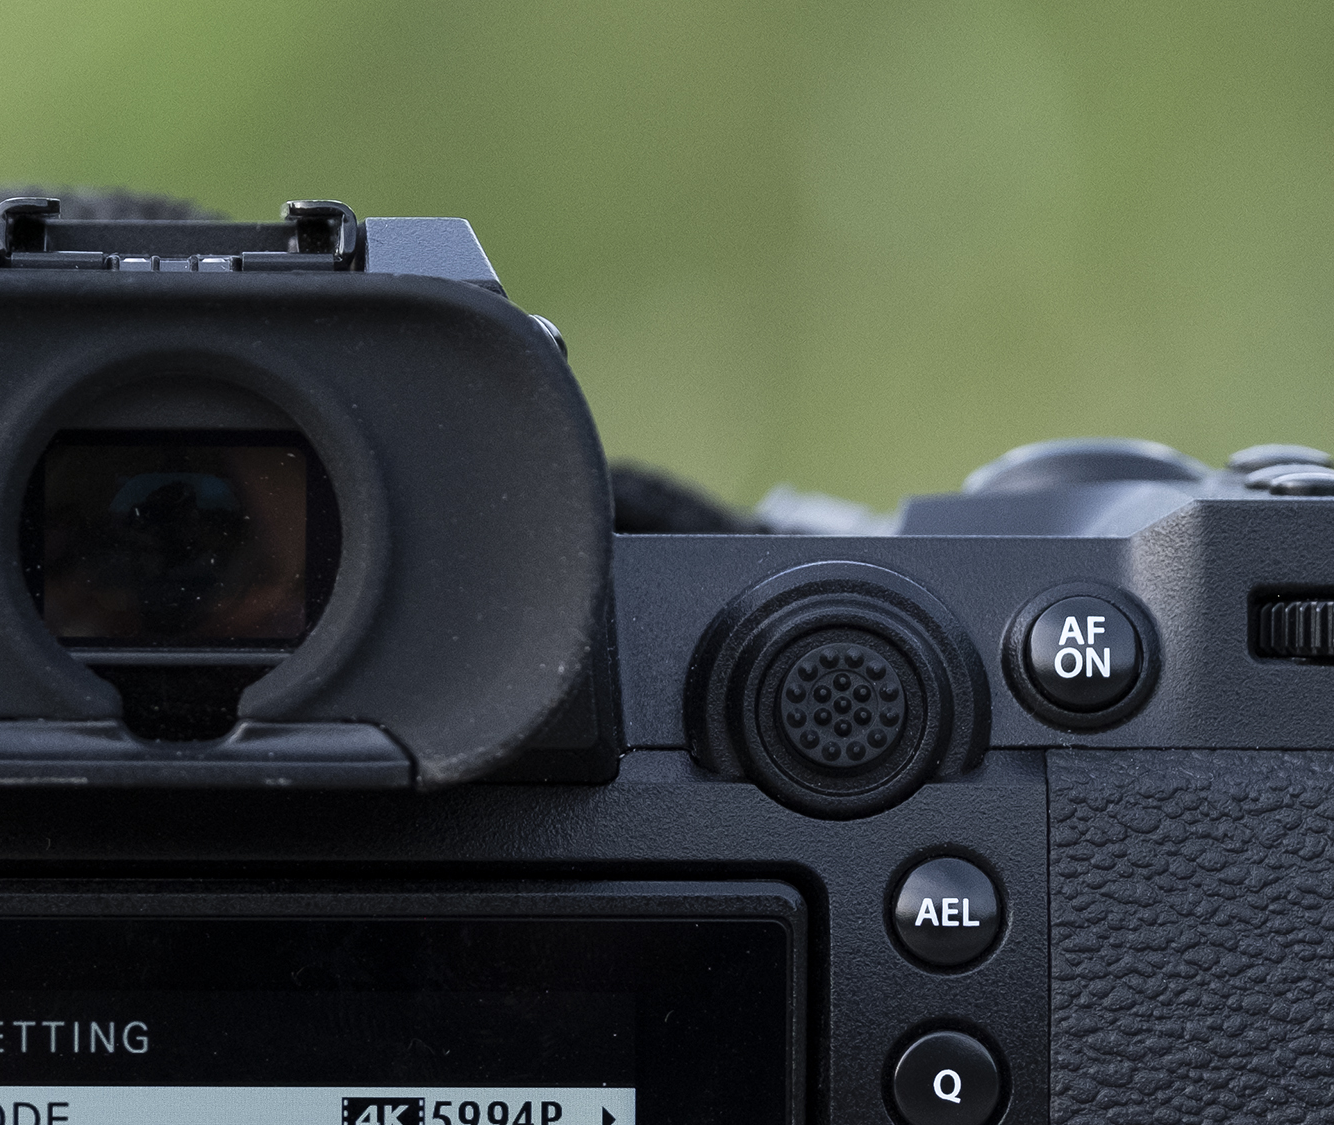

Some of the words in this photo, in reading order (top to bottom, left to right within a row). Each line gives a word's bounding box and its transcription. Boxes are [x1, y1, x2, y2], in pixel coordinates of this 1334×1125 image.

[1058, 615, 1106, 646] AF
[1053, 646, 1111, 679] ON
[914, 897, 980, 928] AEL
[933, 1068, 962, 1104] Q
